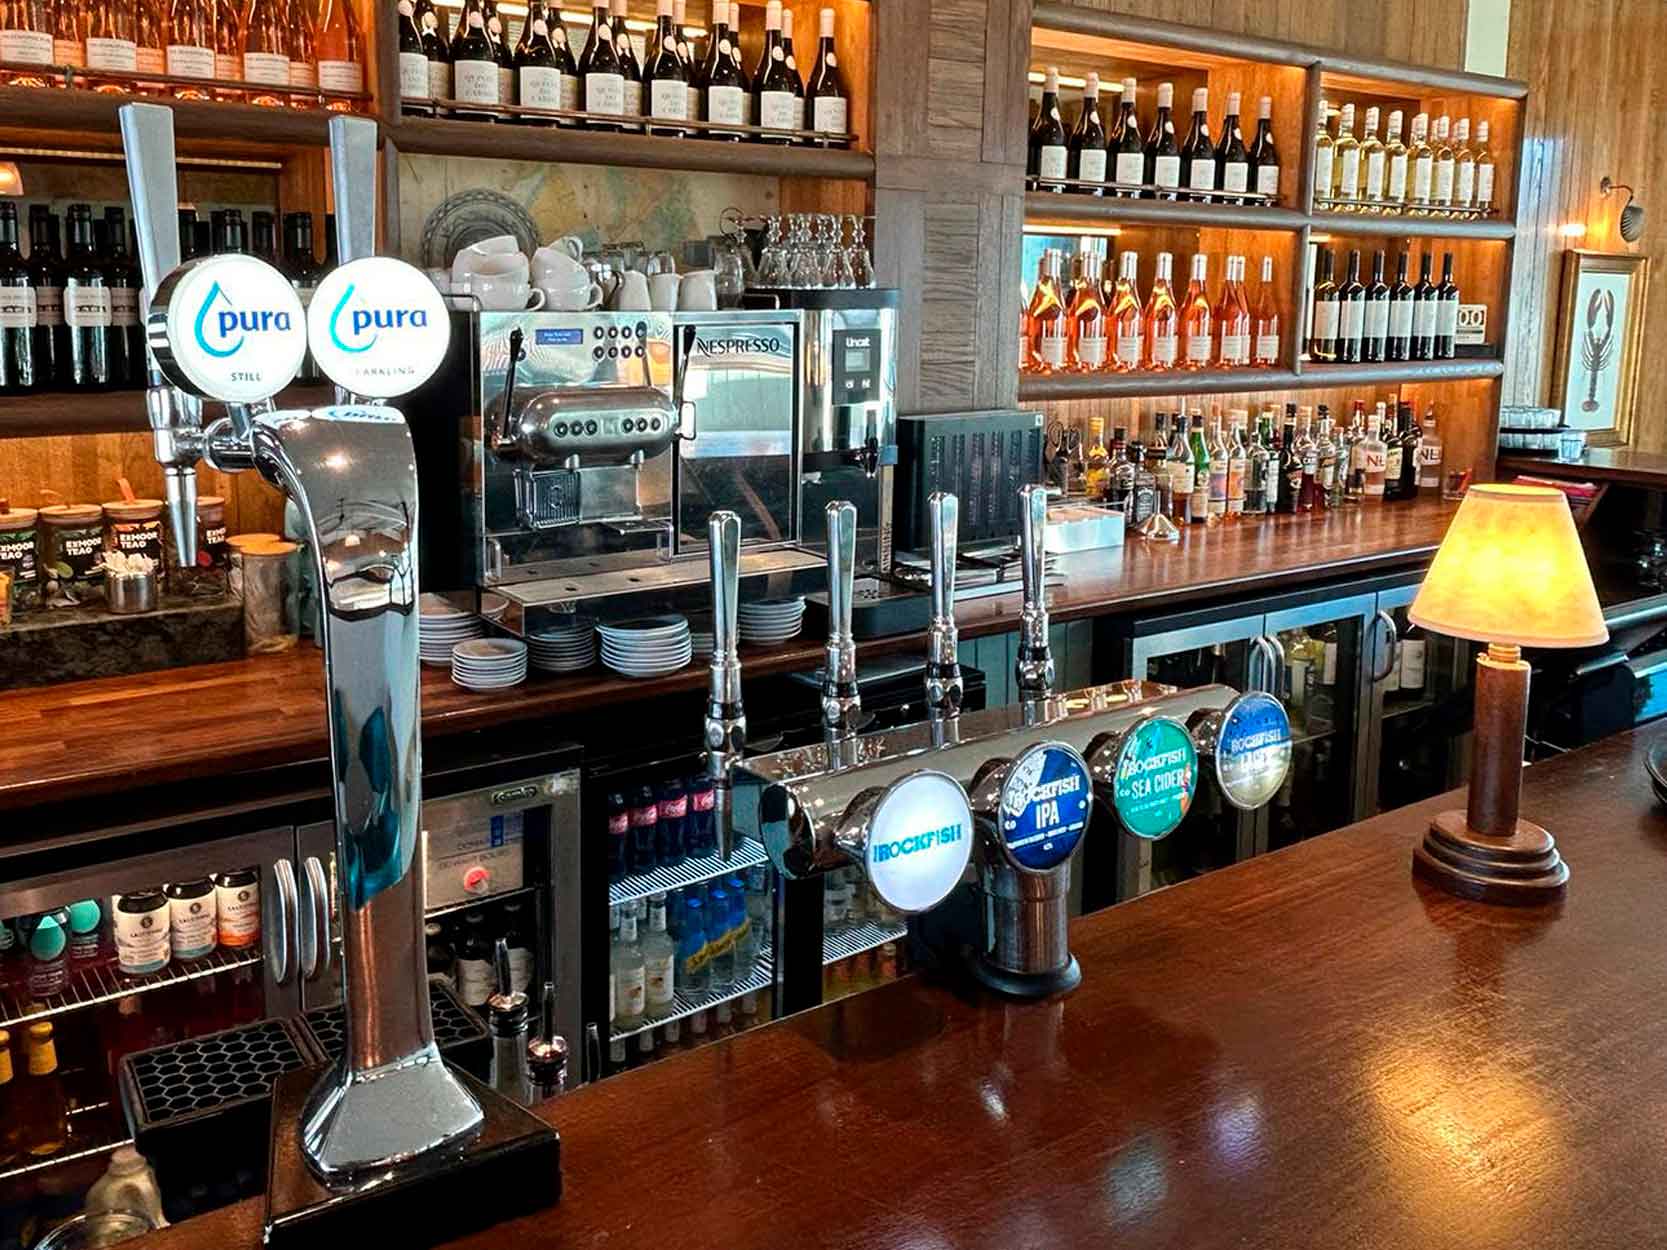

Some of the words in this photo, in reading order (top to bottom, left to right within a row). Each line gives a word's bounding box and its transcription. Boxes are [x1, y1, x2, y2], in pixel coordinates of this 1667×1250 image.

[218, 310, 291, 338] pura
[352, 308, 427, 336] pura
[696, 336, 780, 358] NESPRESSO
[230, 371, 262, 383] STILL
[353, 366, 417, 377] ARKLING
[65, 536, 102, 548] EXMOOR
[119, 531, 158, 542] EXMOOR
[206, 527, 226, 538] EXMO
[1127, 747, 1187, 777] ROCKFISH
[1131, 780, 1151, 800] SEA
[1154, 769, 1185, 793] CIDER
[1035, 799, 1061, 830] IPA
[873, 822, 963, 863] ROCKFISH
